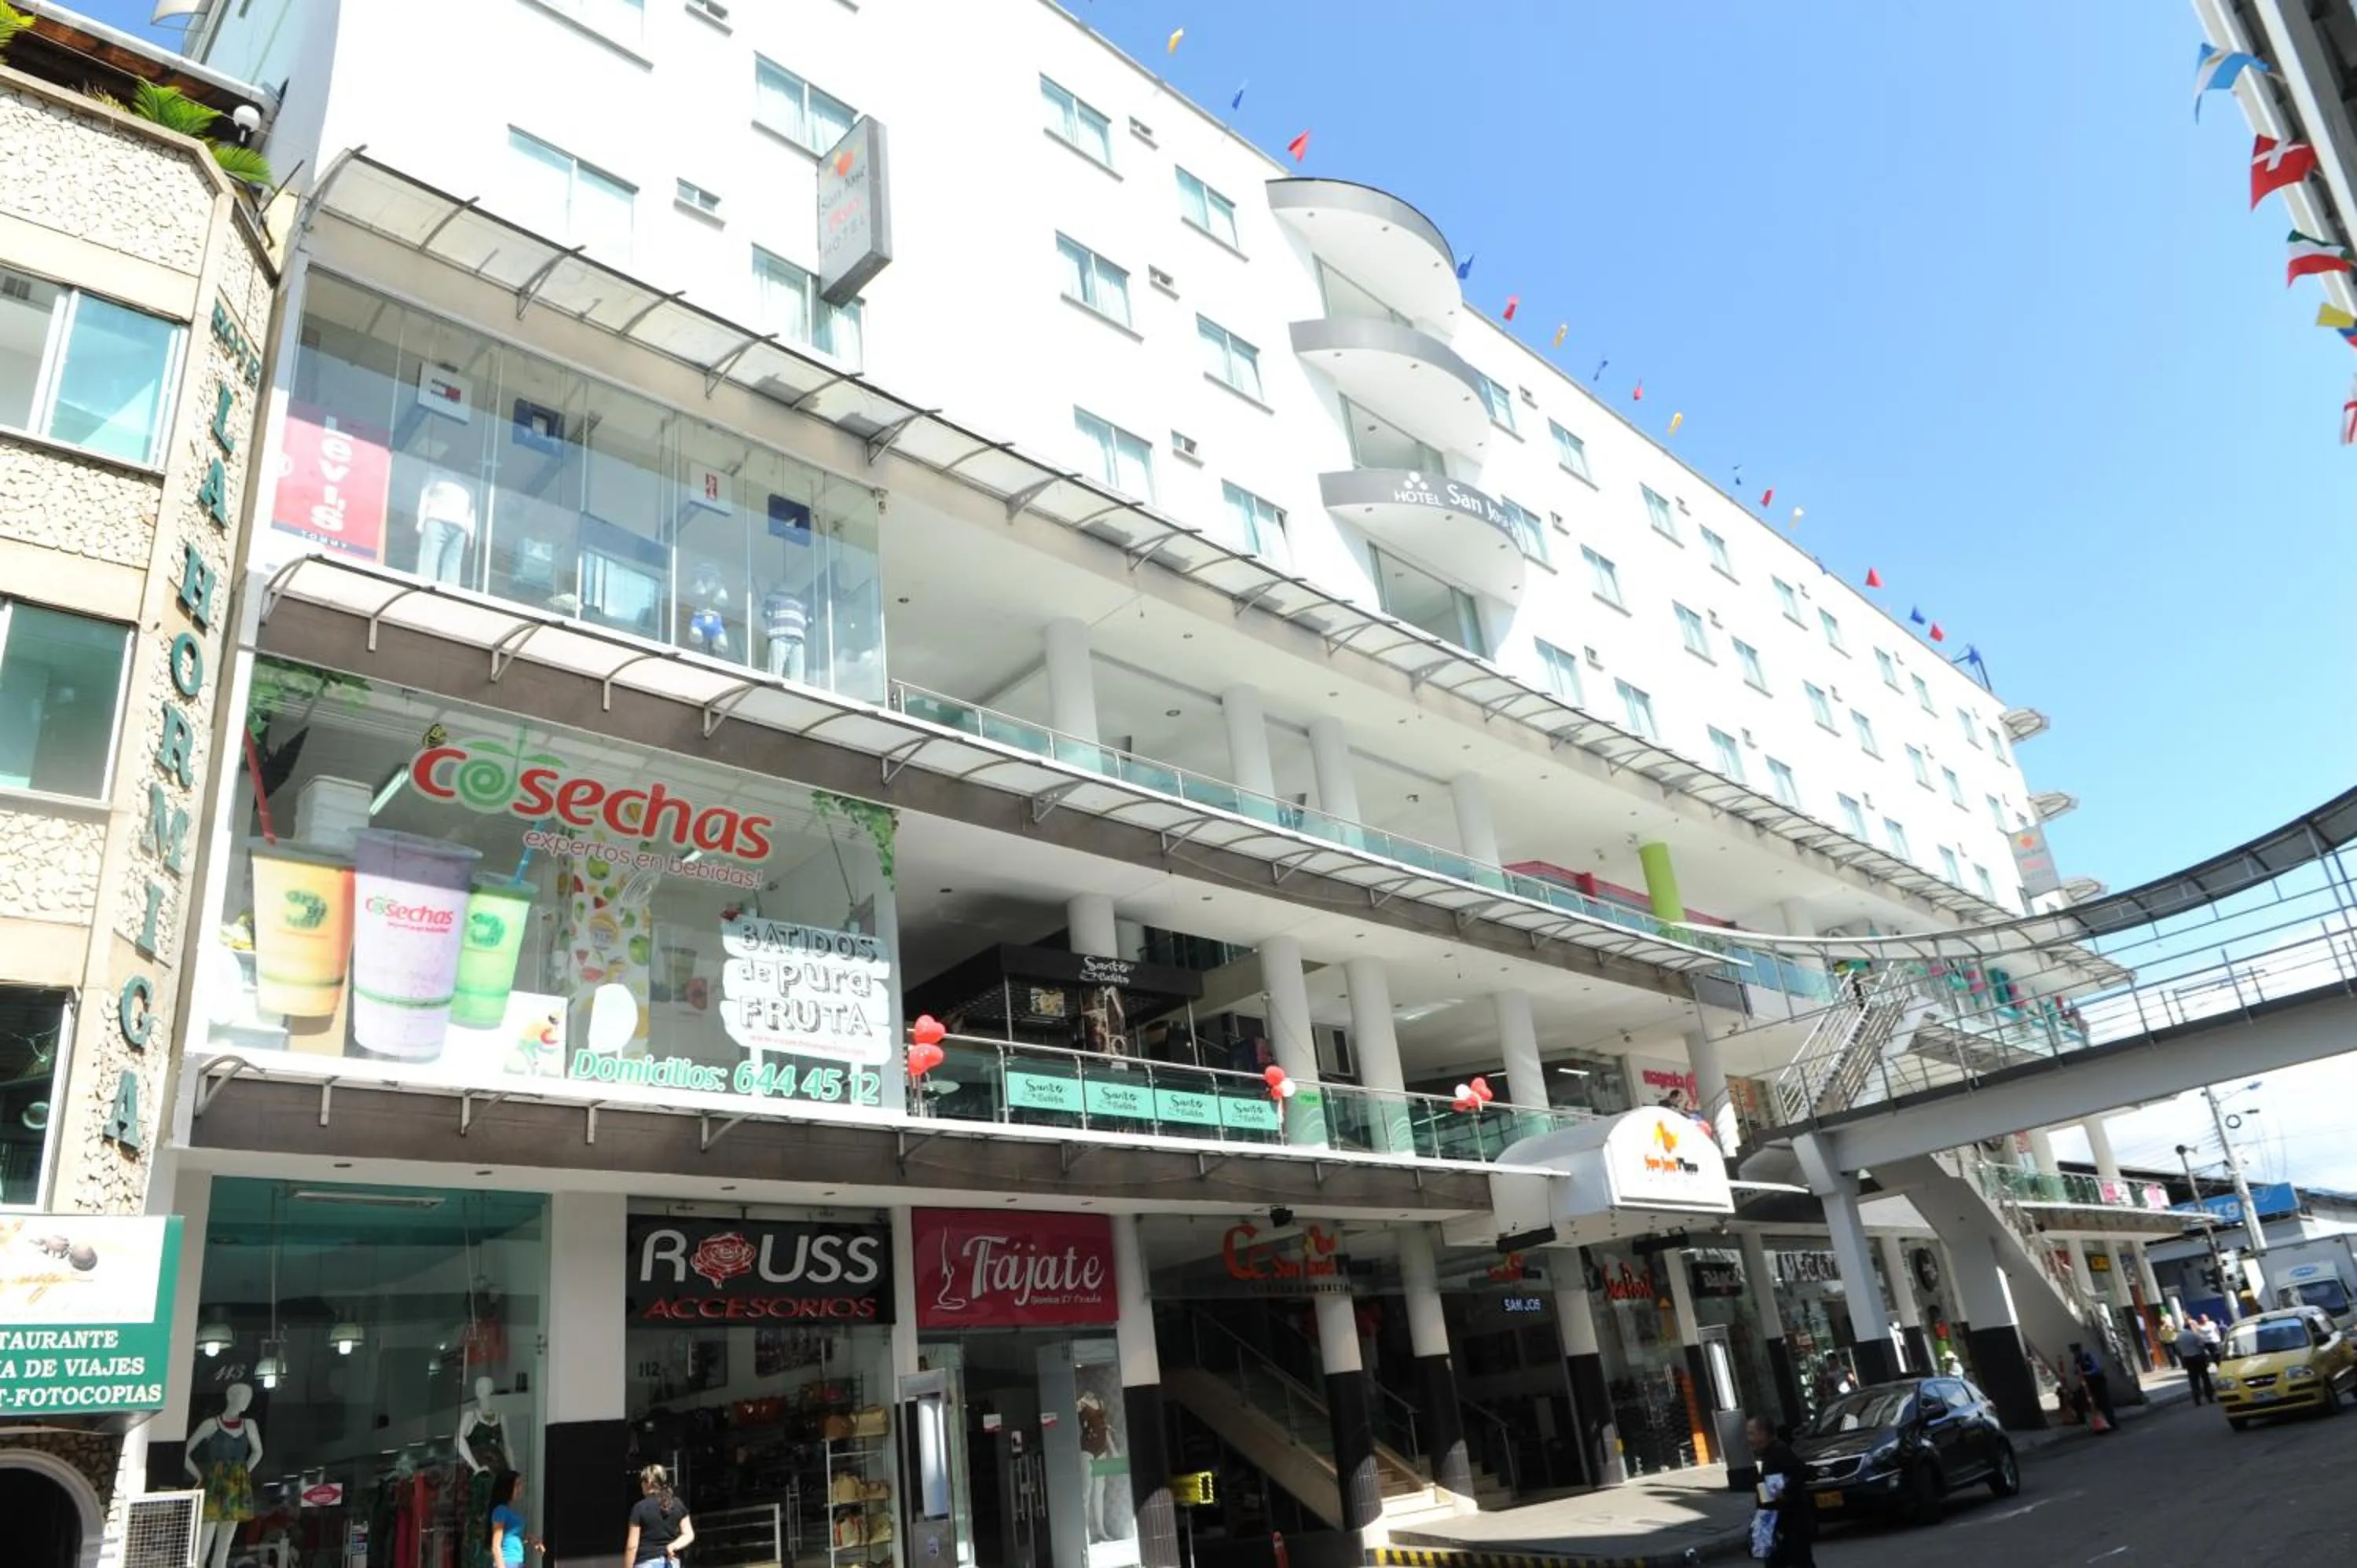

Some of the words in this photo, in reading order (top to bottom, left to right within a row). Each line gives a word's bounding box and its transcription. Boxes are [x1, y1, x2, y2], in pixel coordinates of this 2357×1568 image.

[1394, 489, 1445, 507] HOTEL
[1446, 483, 1483, 515] San
[524, 830, 630, 866] expertos
[636, 851, 665, 870] en
[665, 852, 764, 890] bebidas!
[740, 919, 879, 963] BATIDOS
[739, 959, 771, 983] de
[1084, 956, 1127, 973] Santo
[739, 995, 874, 1037] FRUTA
[571, 1048, 727, 1091] Domicilios:
[733, 1061, 797, 1098] 644
[801, 1068, 841, 1101] 45
[848, 1072, 881, 1105] 12
[1026, 1079, 1063, 1094] Santo
[1102, 1086, 1137, 1101] Santo
[962, 1232, 1105, 1306] Fájate
[643, 1296, 877, 1319] ACCESORIOS
[24, 1359, 57, 1378] DE
[64, 1357, 145, 1377] VIAJES
